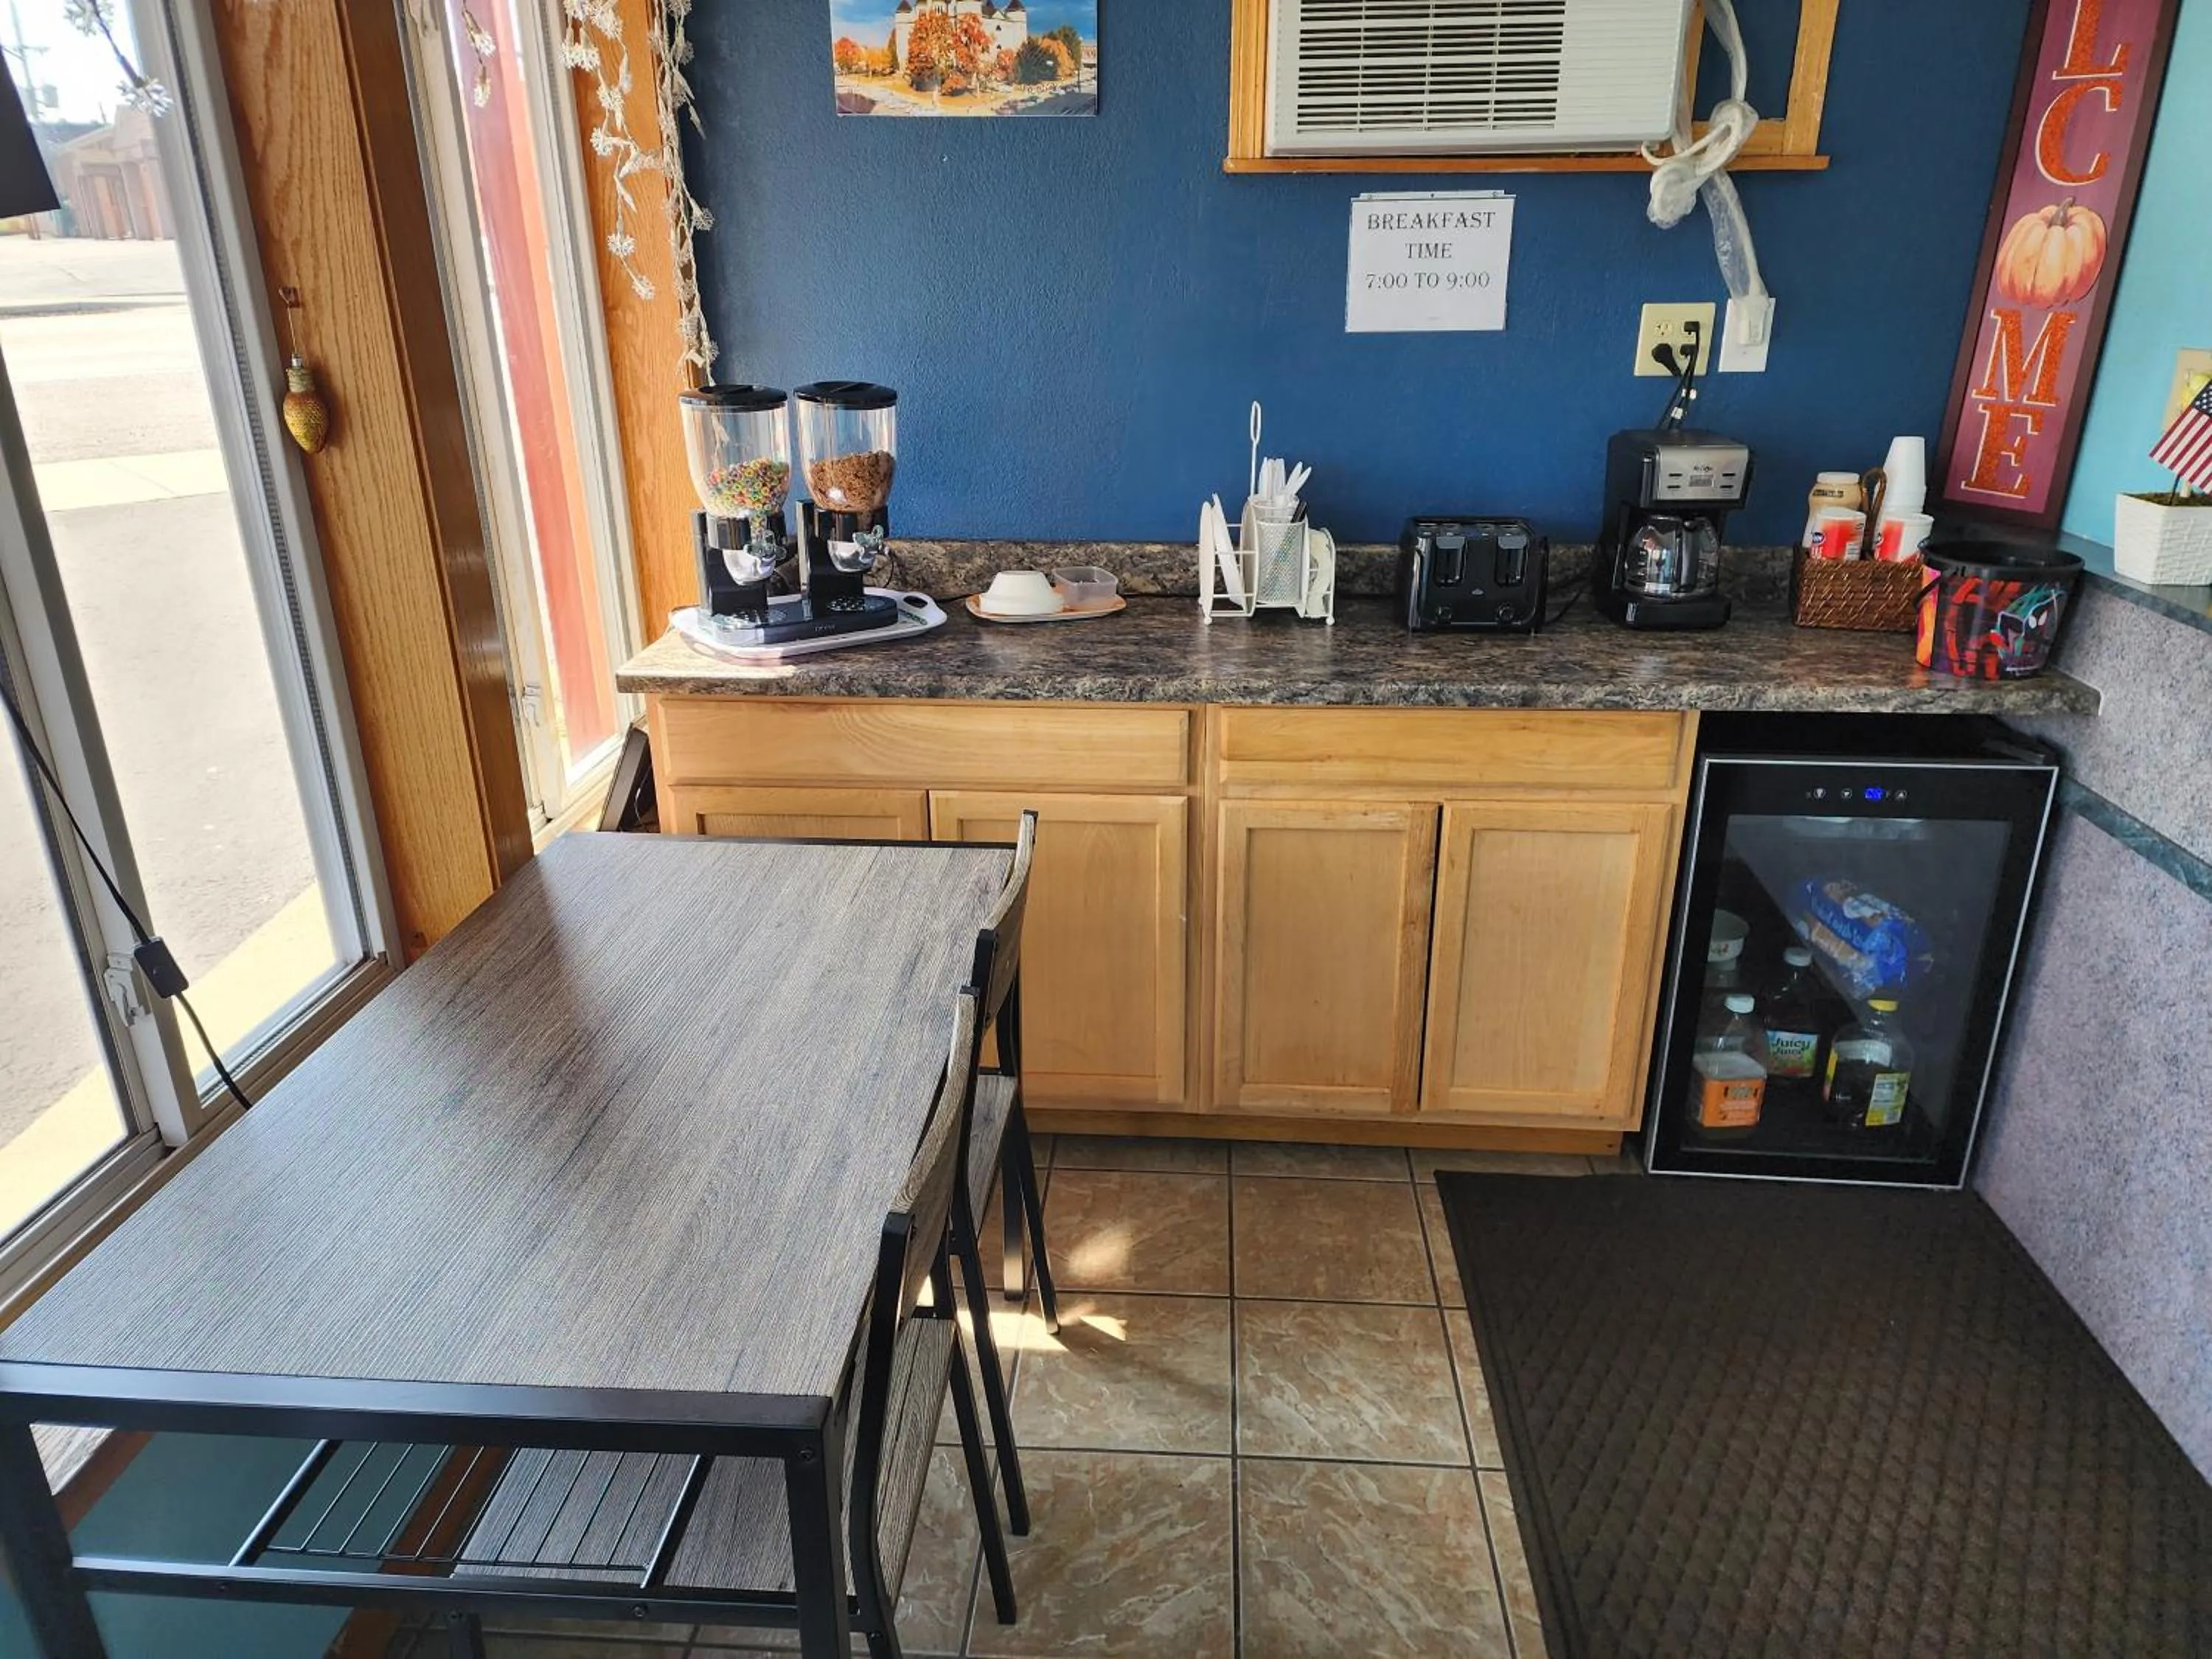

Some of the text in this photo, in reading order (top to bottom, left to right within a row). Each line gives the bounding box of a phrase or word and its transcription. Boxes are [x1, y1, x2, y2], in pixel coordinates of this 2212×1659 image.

[1367, 212, 1496, 230] BREAKFAST
[1405, 243, 1453, 259] TIME
[1366, 271, 1490, 290] 7:00 TO 9:00
[1771, 1037, 1811, 1051] Juicy
